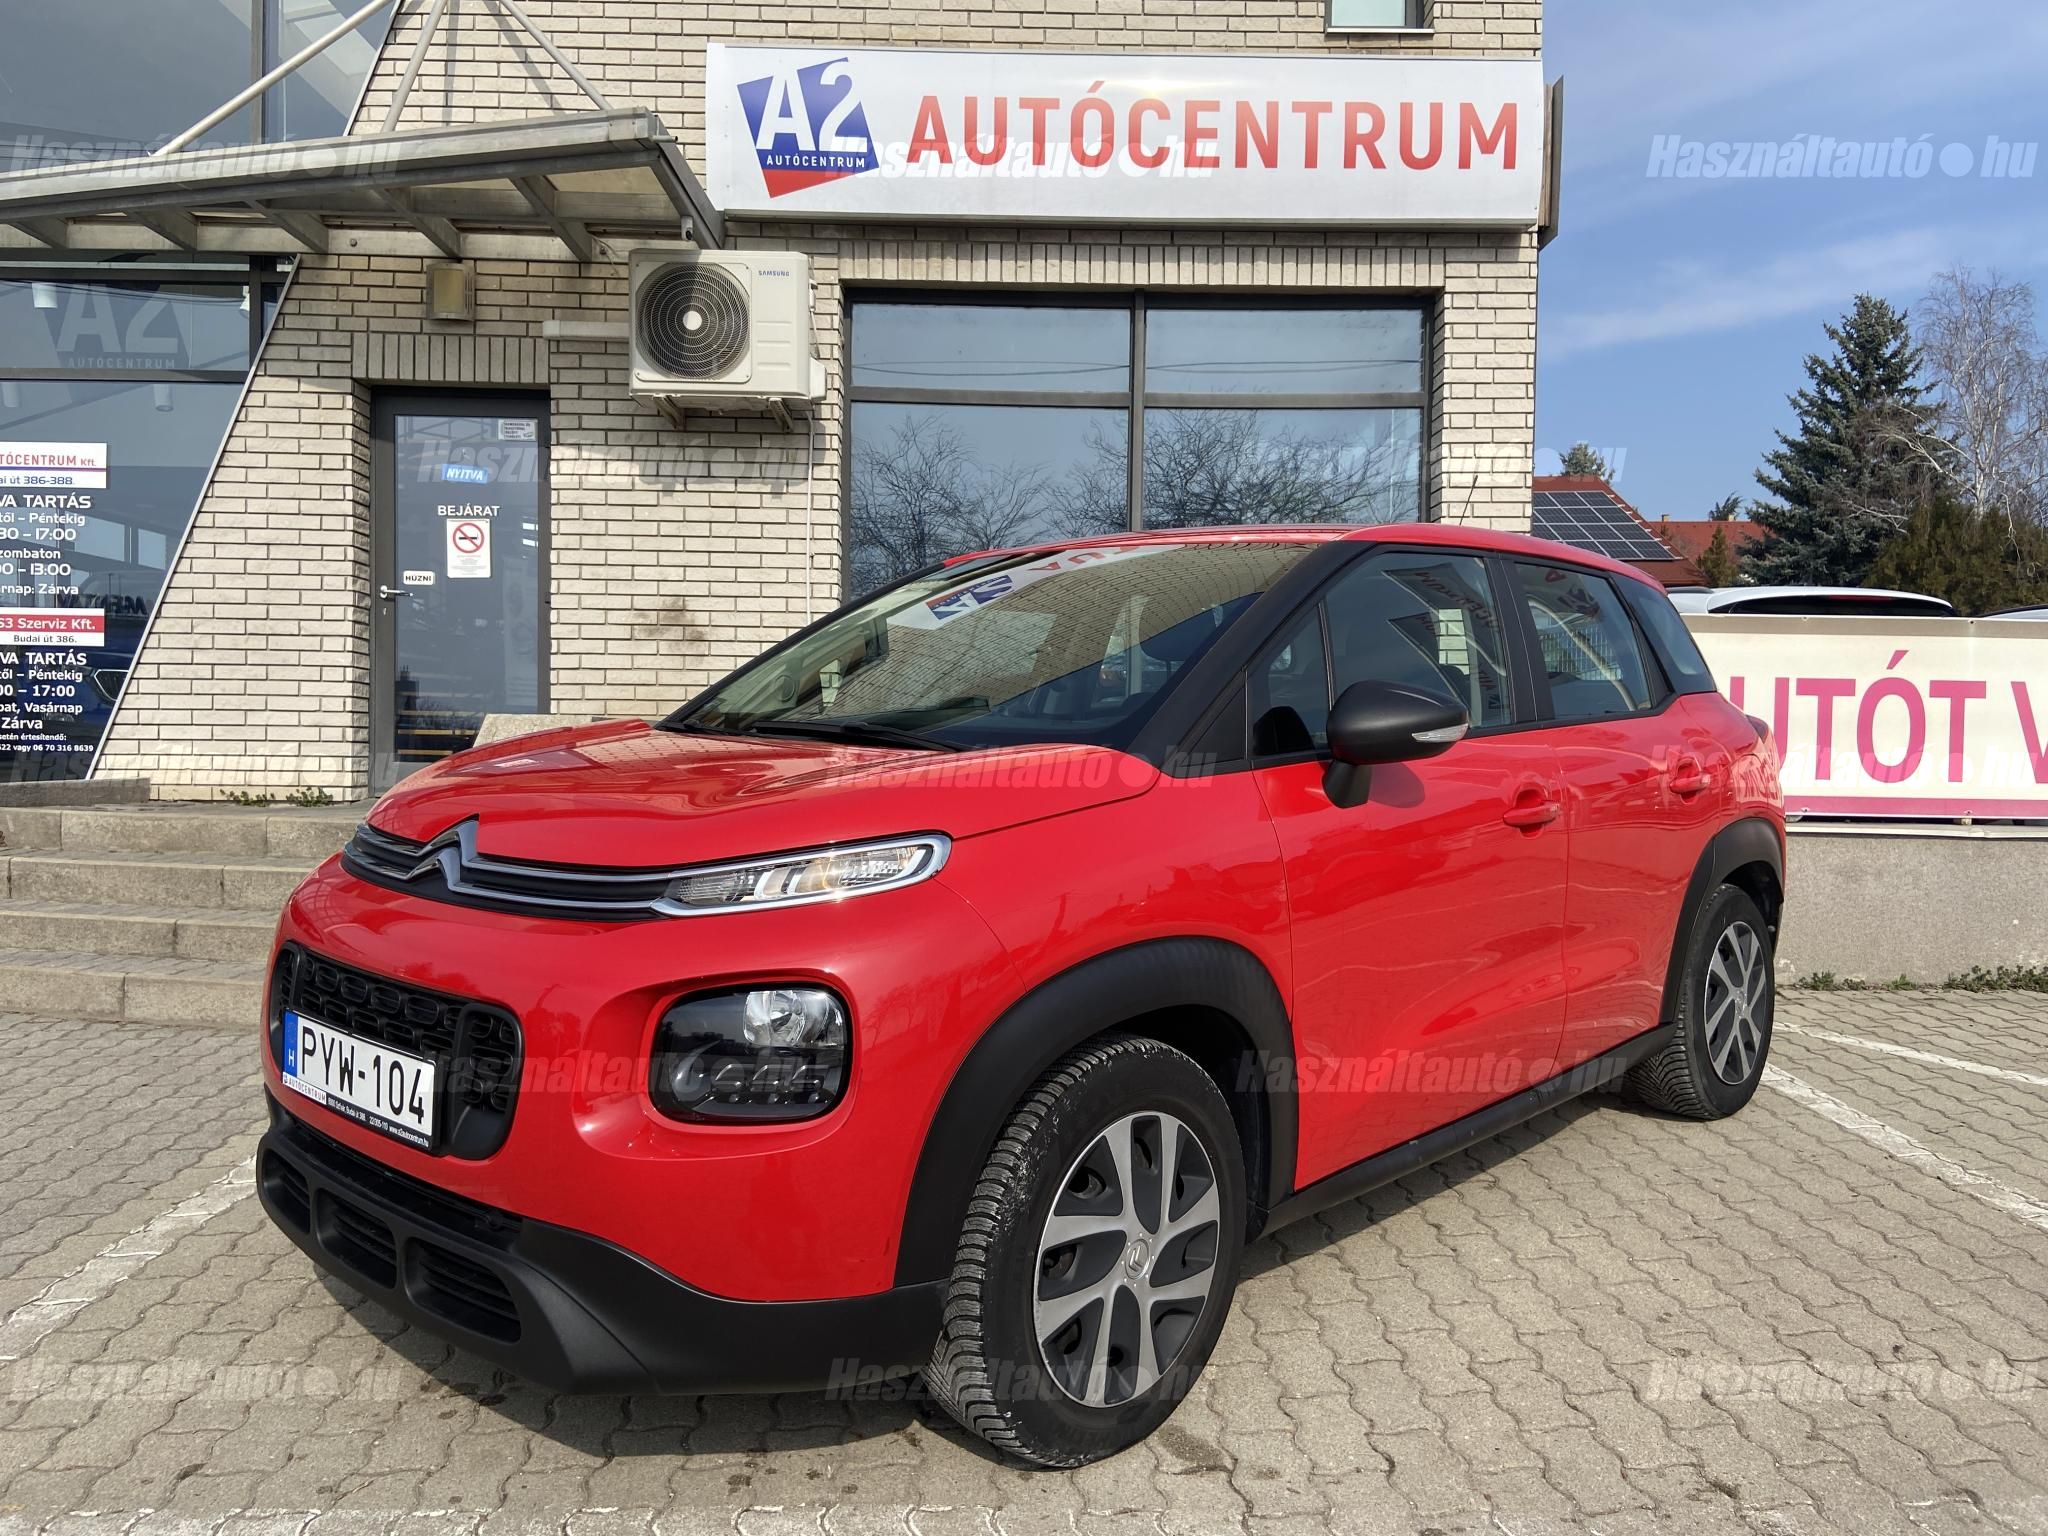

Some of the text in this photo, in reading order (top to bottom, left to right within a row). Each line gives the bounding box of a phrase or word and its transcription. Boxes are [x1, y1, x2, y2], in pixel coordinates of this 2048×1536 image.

[756, 61, 868, 152] A2
[906, 80, 1517, 169] AUTÓCENTRUM
[766, 153, 866, 168] AUTÓCENTRUM
[447, 468, 484, 480] NYITVA
[22, 491, 92, 509] TARTÁS
[437, 503, 500, 516] BEJÁRAT
[29, 512, 86, 527] Péntekig
[35, 527, 77, 541] 17:00
[30, 562, 71, 576] 13:00
[38, 583, 79, 595] Zárva
[17, 618, 67, 630] Szerviz
[71, 618, 96, 630] Kft.
[13, 634, 78, 643] Budai út 386.
[25, 648, 87, 666] TARTÁS
[28, 668, 83, 683] Péntekig
[32, 684, 76, 697] 17:00
[24, 701, 83, 716] Vasárnap
[1, 715, 43, 730] Zárva
[13, 744, 31, 752] vagy
[33, 744, 44, 752] 06
[45, 744, 55, 752] 70
[57, 744, 72, 752] 316
[288, 1048, 295, 1067] H
[302, 1025, 425, 1125] PYW-104
